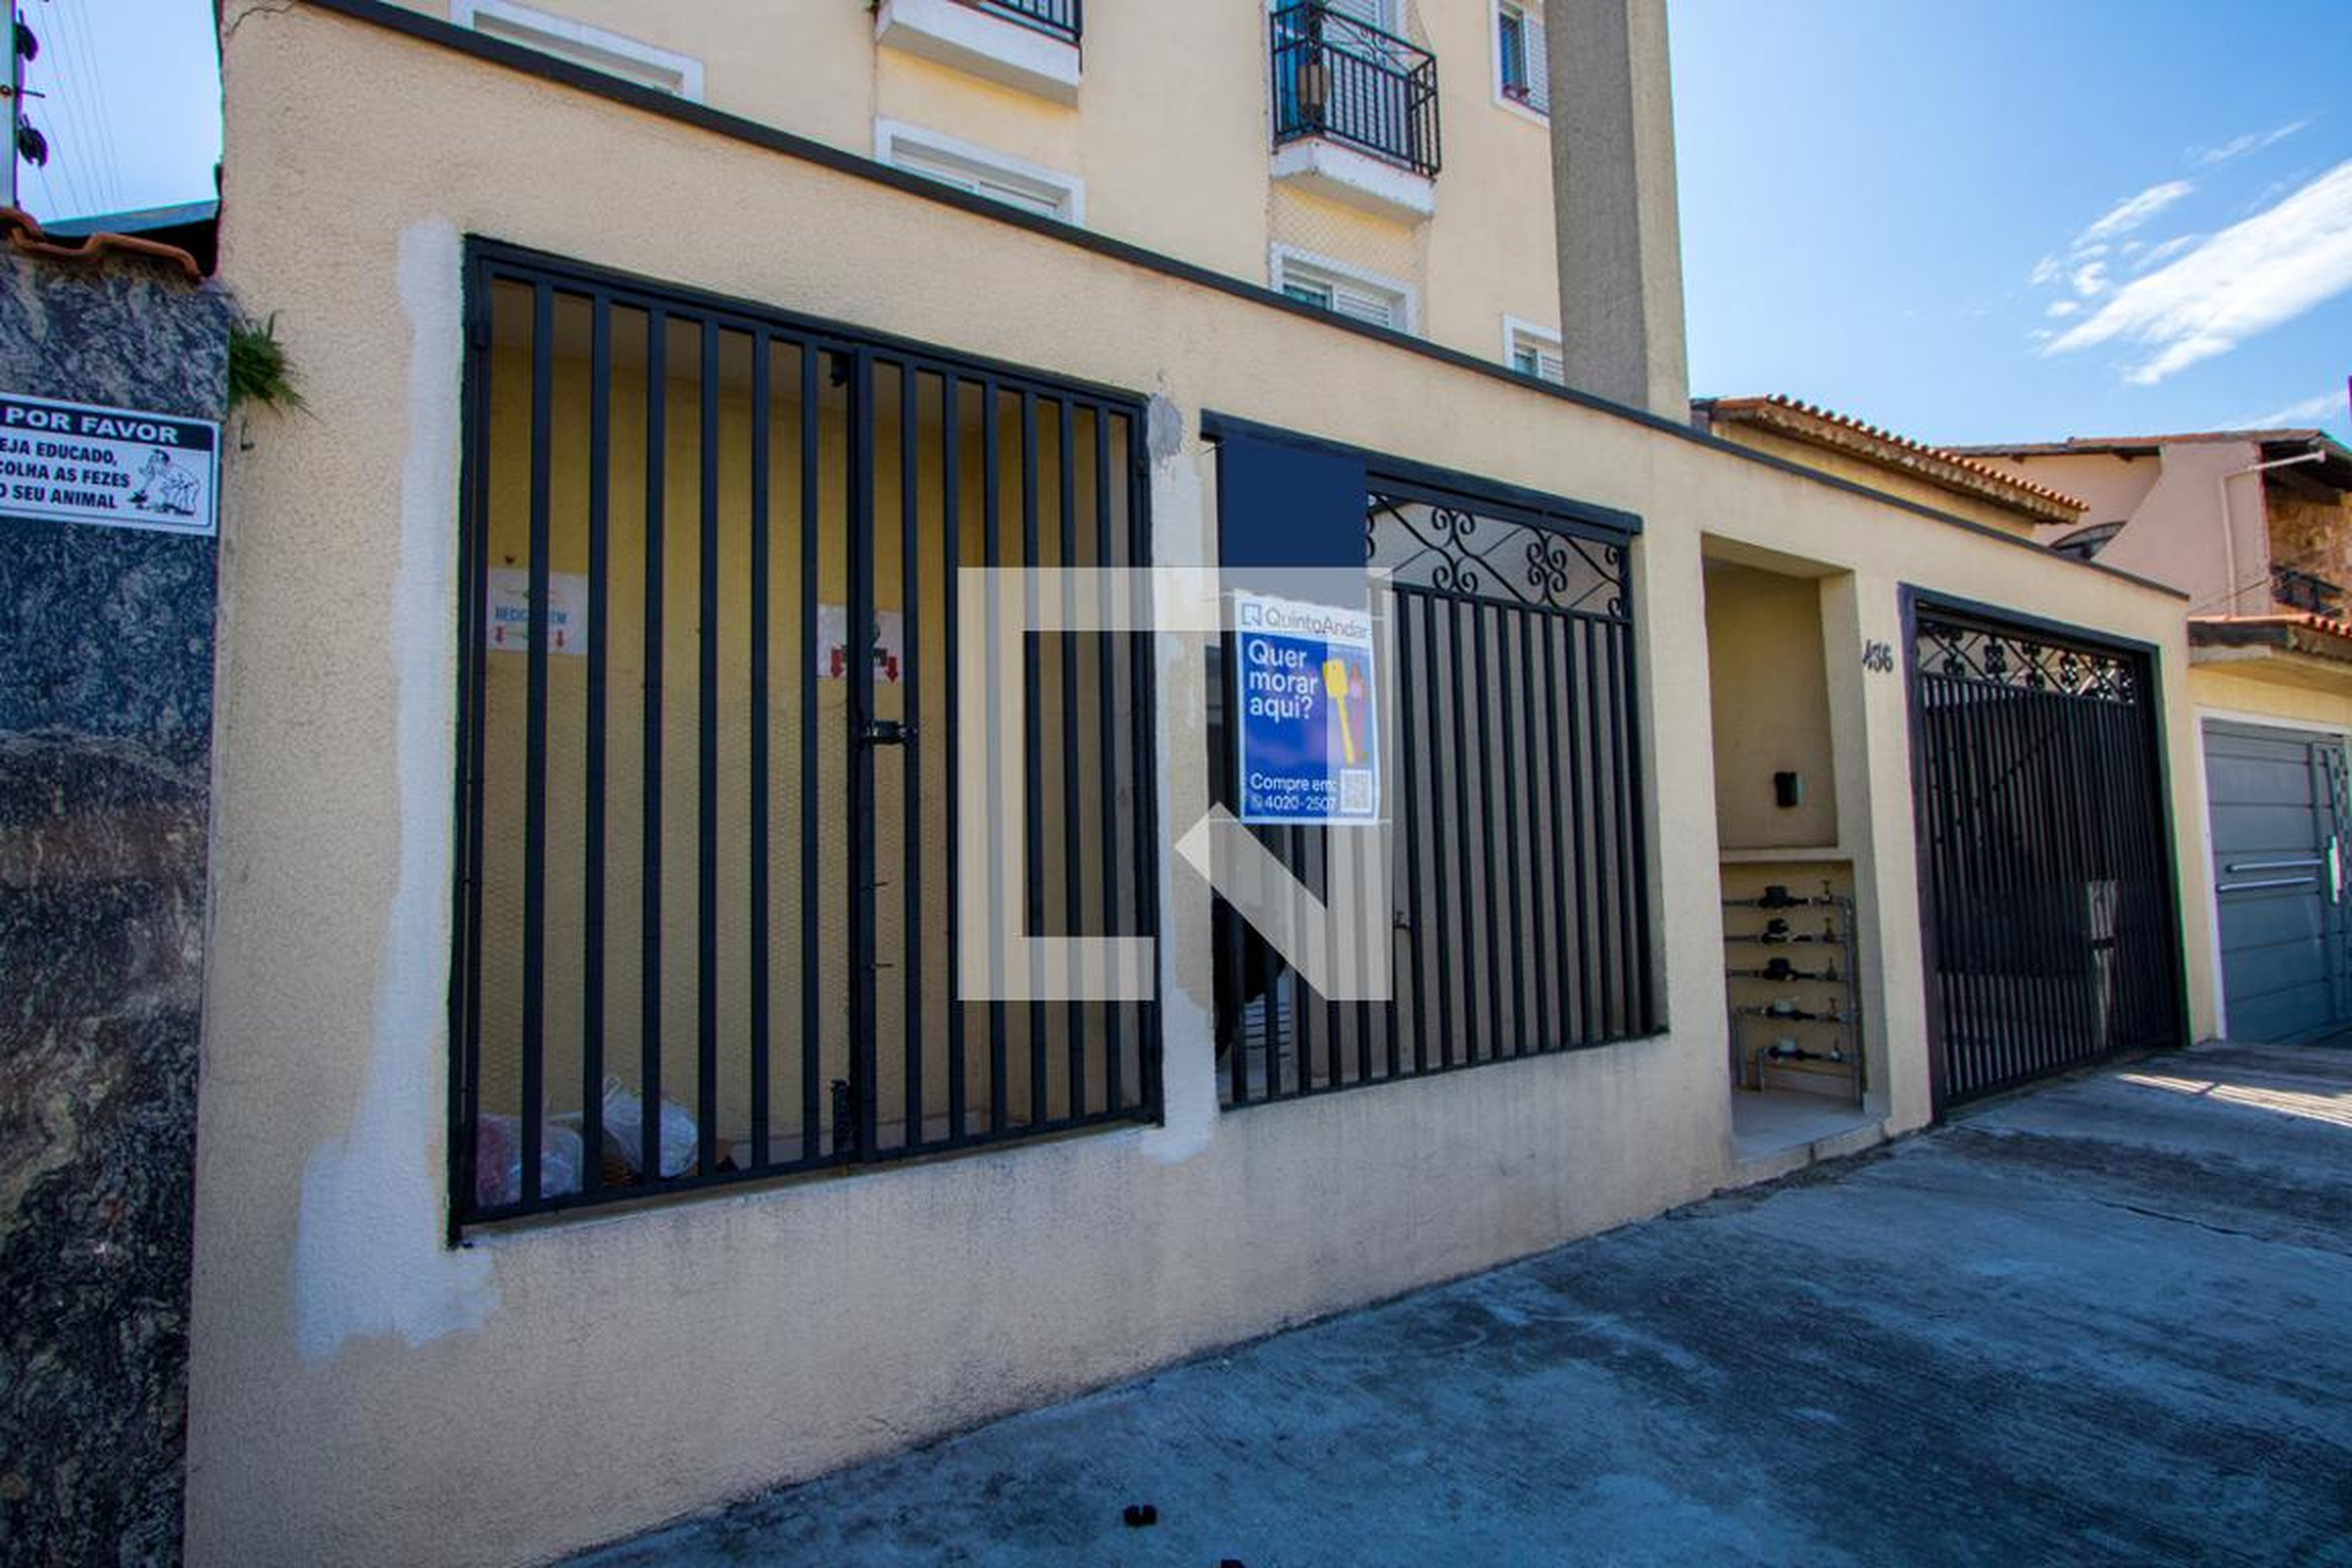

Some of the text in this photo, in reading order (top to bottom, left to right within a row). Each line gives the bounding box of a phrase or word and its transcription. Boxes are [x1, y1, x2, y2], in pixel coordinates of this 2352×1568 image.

[5, 407, 179, 445] POR FAVOR
[36, 442, 118, 467] EDUCADO,
[54, 467, 78, 483] AS
[81, 470, 131, 488] FEZES
[12, 485, 45, 501] SEU
[50, 488, 118, 509] ANIMAL
[1265, 607, 1370, 639] QuintoAndar
[1249, 639, 1307, 669] Quer
[1250, 670, 1319, 695] morar
[1250, 696, 1313, 724] aqui?
[1250, 772, 1310, 794] Compre
